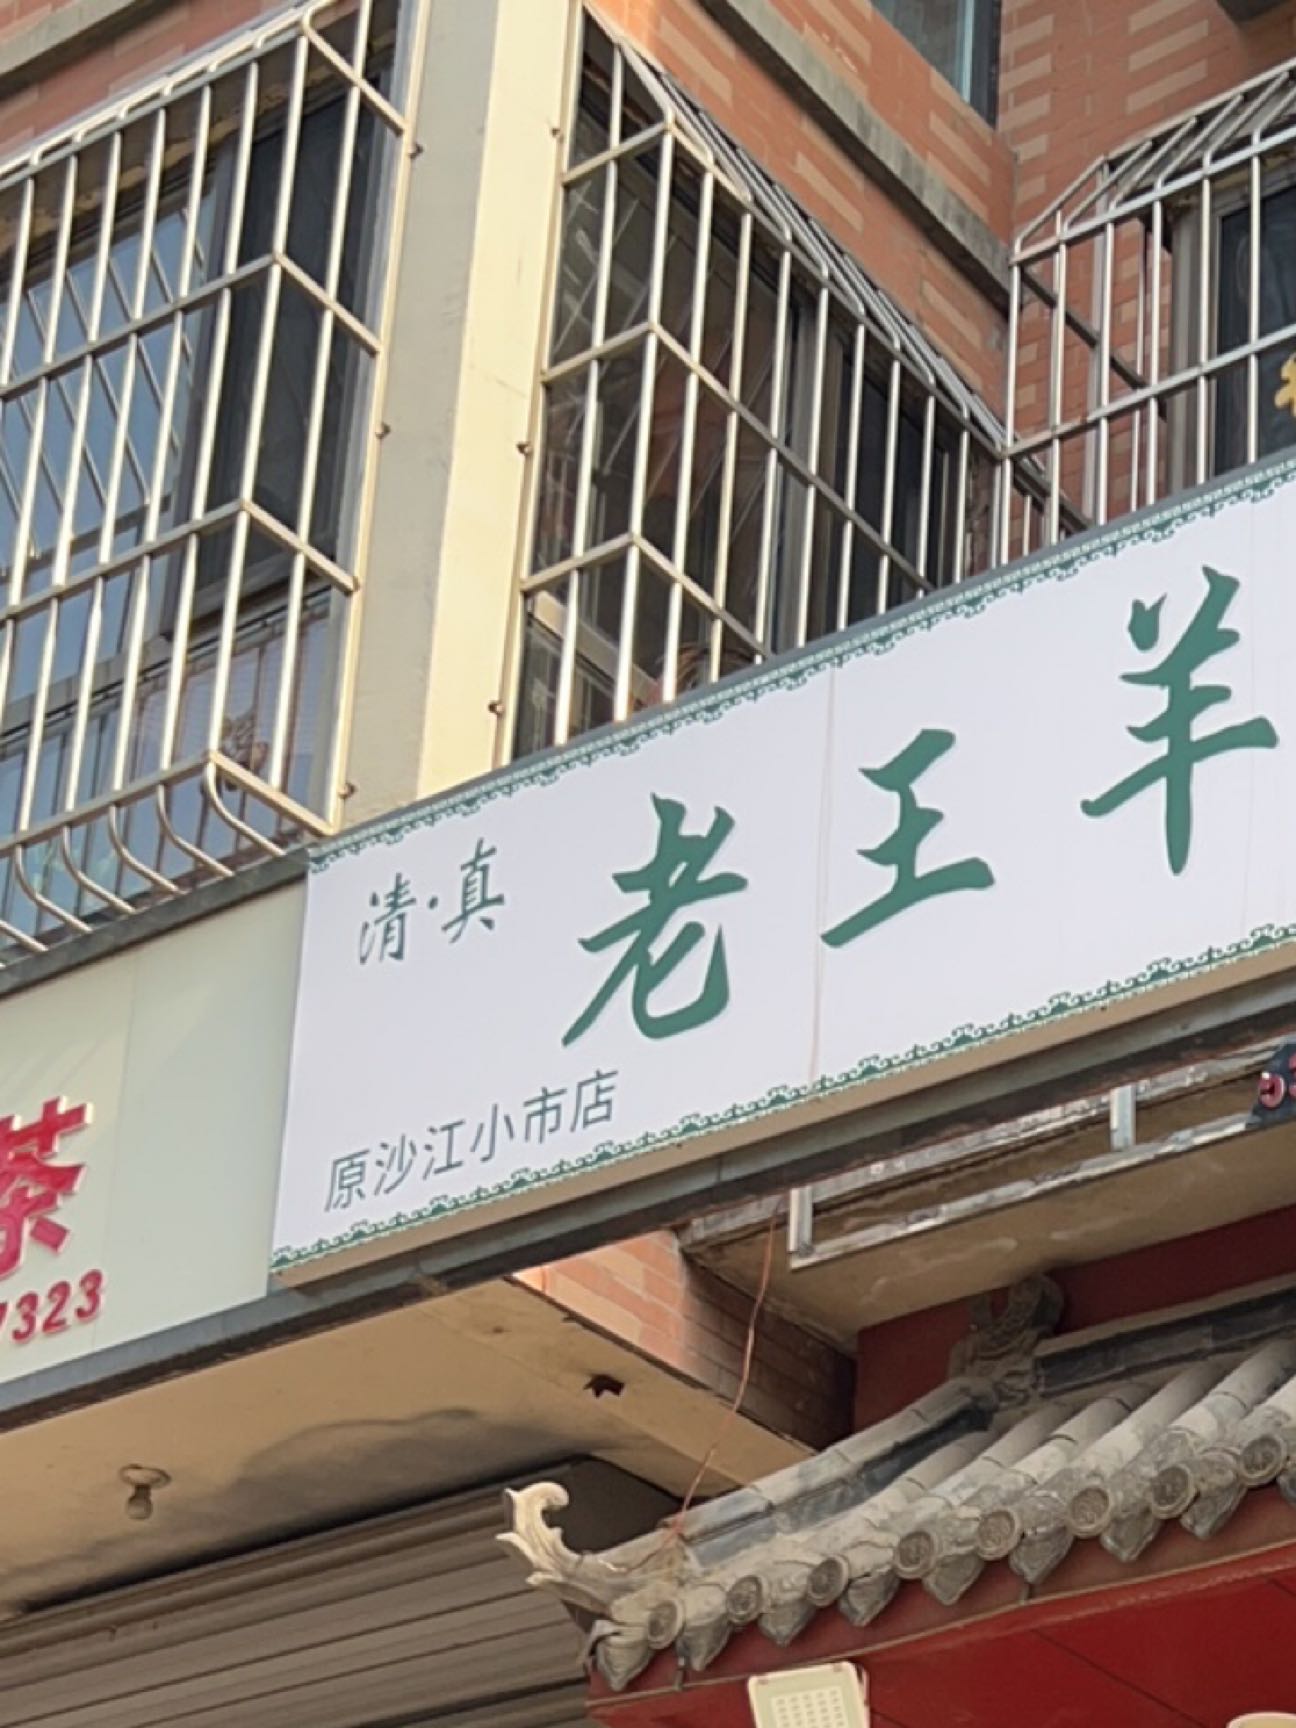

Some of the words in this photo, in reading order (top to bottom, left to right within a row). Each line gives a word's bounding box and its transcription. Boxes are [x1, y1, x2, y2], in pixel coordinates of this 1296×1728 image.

[324, 1069, 619, 1213] 原沙江小市店
[0, 1268, 104, 1343] 323
